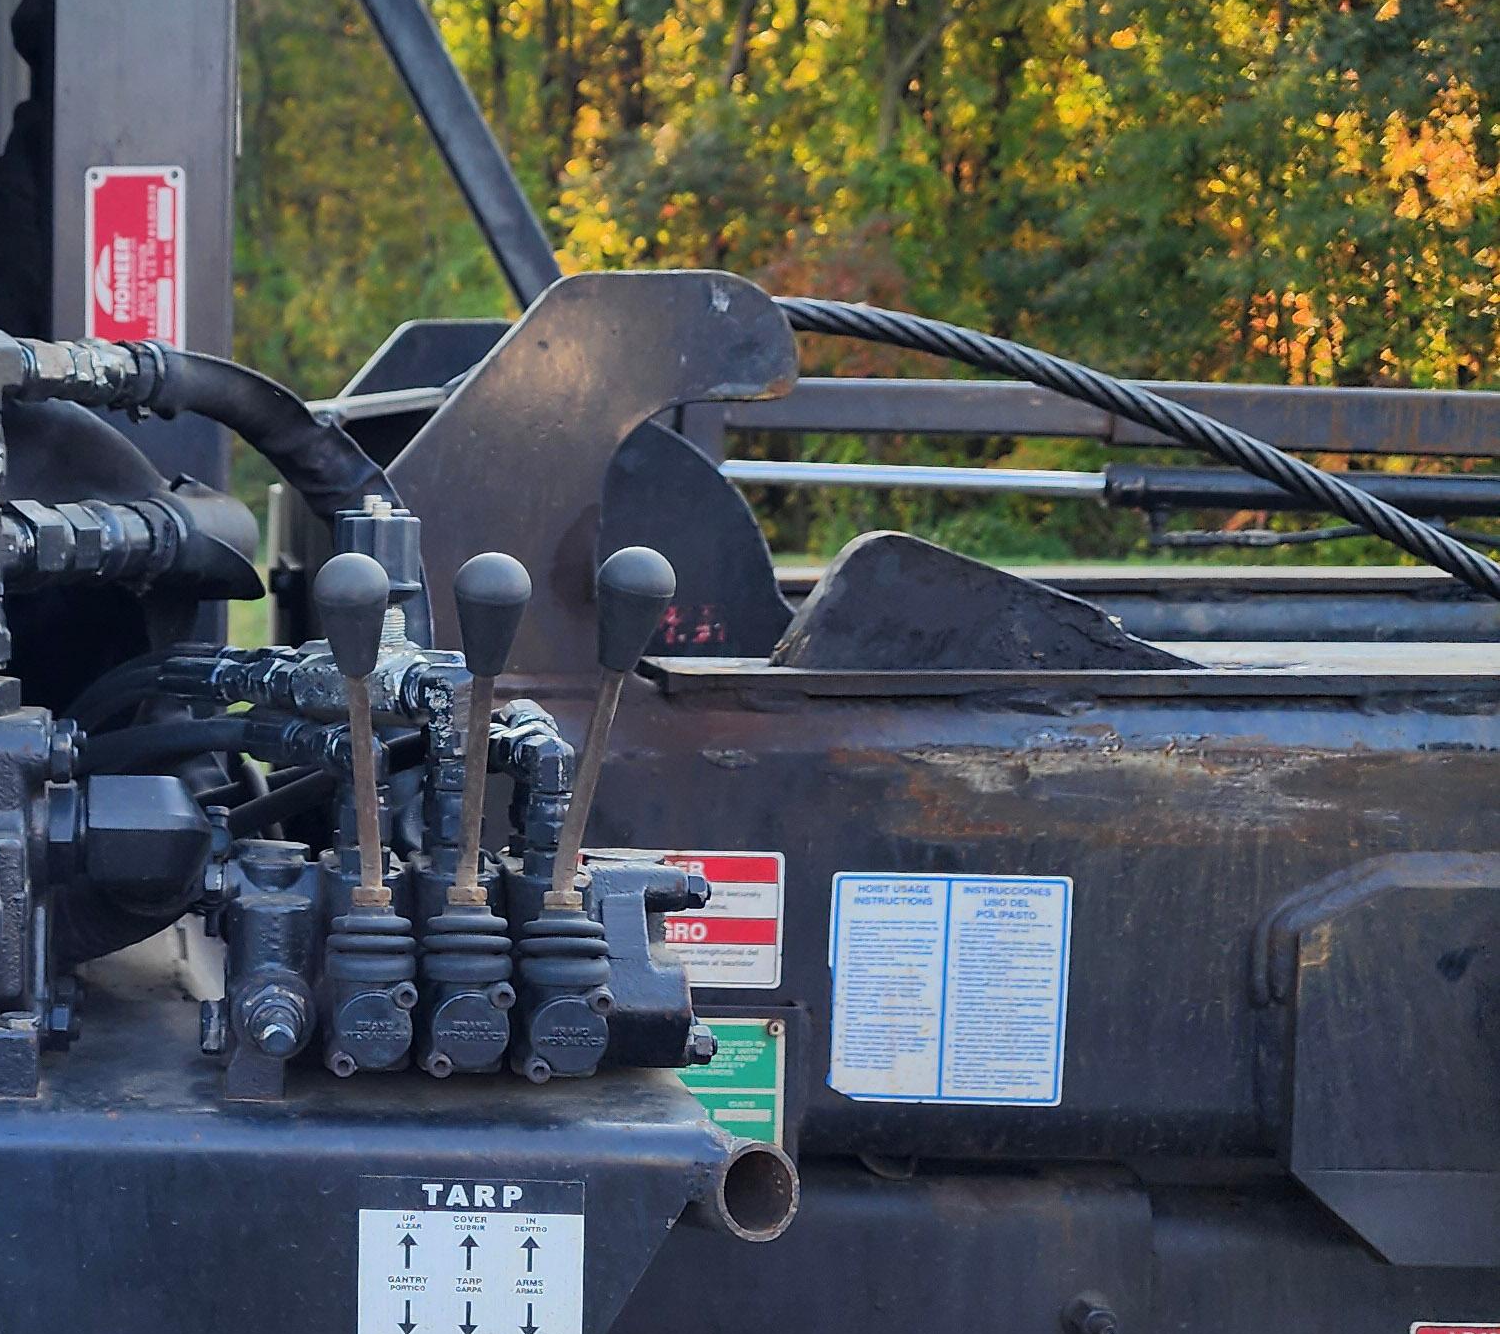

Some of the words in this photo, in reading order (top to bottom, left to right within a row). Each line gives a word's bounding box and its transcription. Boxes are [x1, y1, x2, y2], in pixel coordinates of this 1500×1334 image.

[113, 236, 131, 323] PIONEER
[858, 884, 890, 895] HOIST
[893, 884, 930, 895] USAGE
[963, 885, 1052, 897] INSTRUCCIONES
[854, 896, 933, 907] INSTRUCTIONS
[421, 1183, 523, 1208] TARP
[402, 1214, 416, 1223] UP
[453, 1215, 488, 1224] COVER
[525, 1217, 537, 1225] IN
[387, 1275, 429, 1284] GANTRY
[455, 1277, 483, 1286] TARP
[515, 1279, 544, 1287] ARMS
